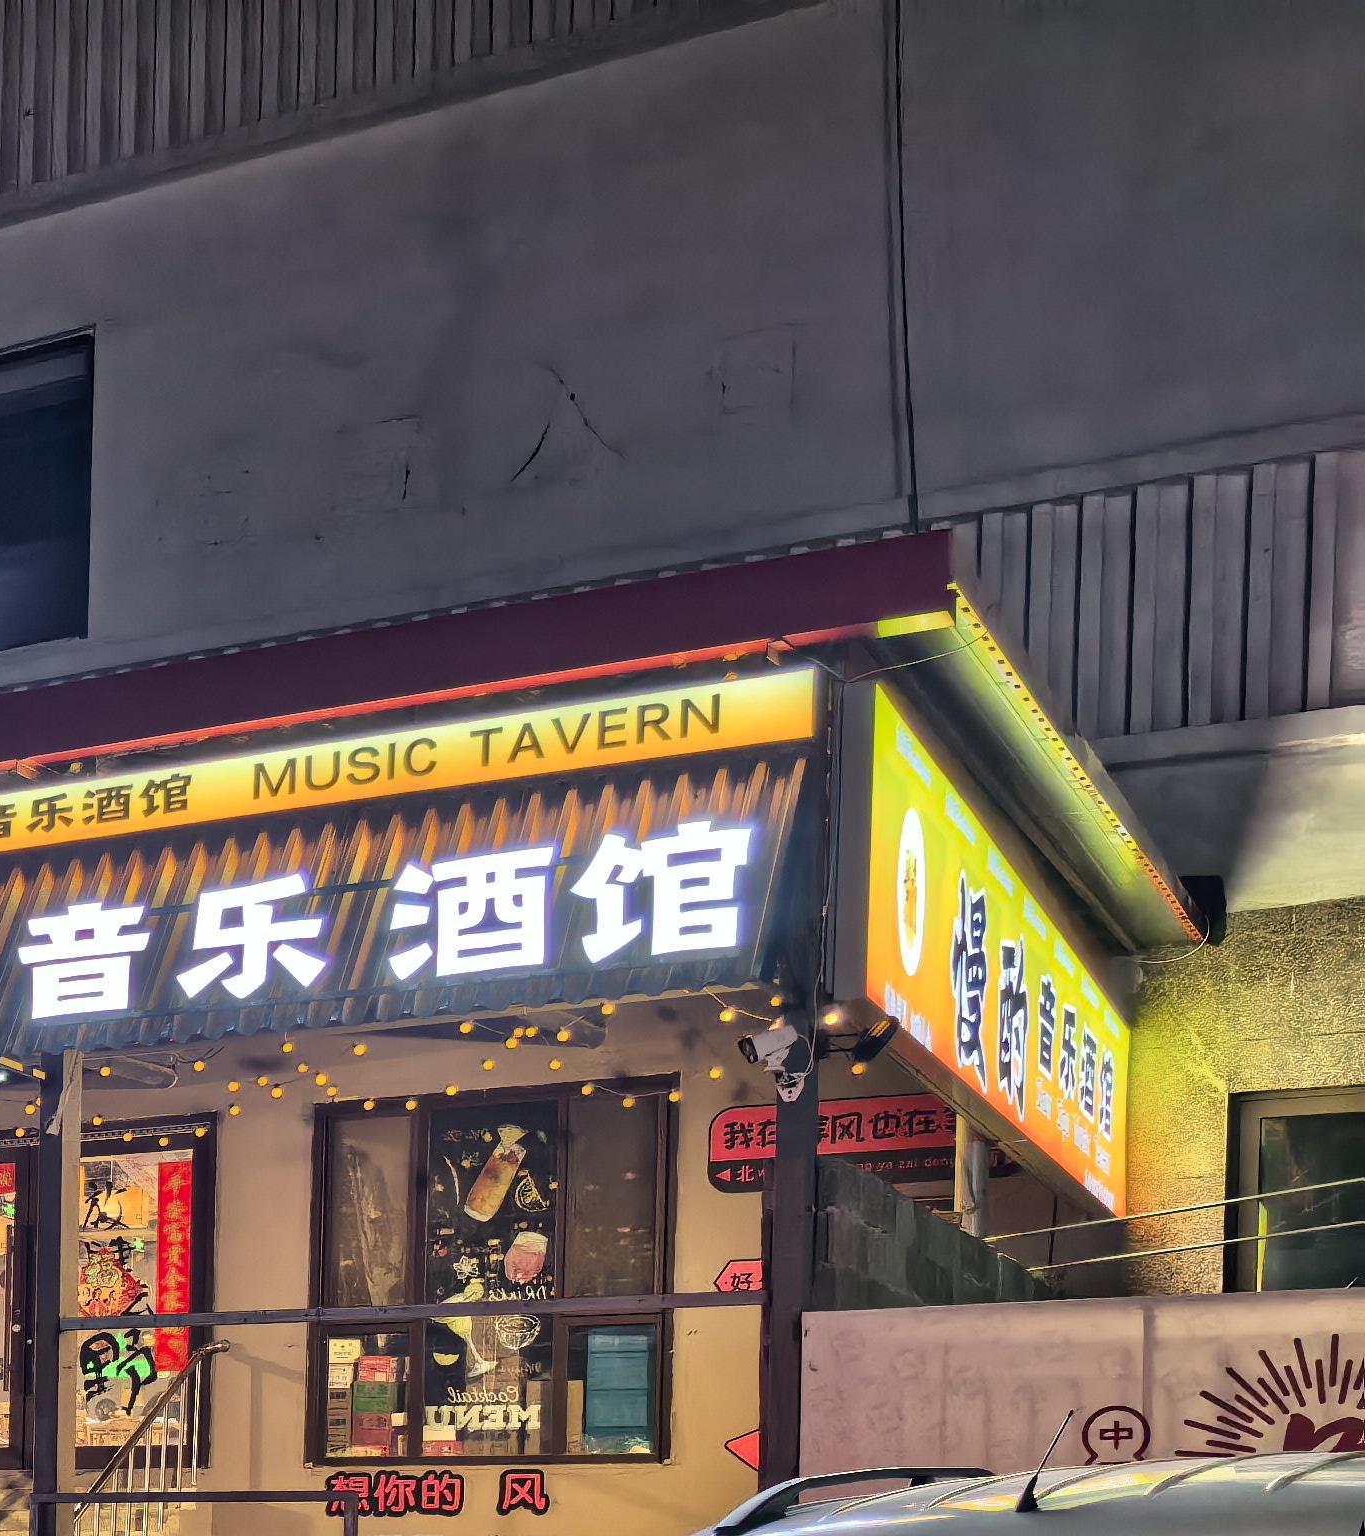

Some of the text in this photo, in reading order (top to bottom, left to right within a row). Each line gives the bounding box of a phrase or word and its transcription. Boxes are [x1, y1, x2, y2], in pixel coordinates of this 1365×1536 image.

[252, 694, 722, 801] MUSIC TAVERN
[18, 872, 328, 1020] 音乐
[388, 819, 753, 982] 酒馆
[1039, 975, 1116, 1141] 音乐酒馆
[326, 1468, 550, 1517] 想你的 风
